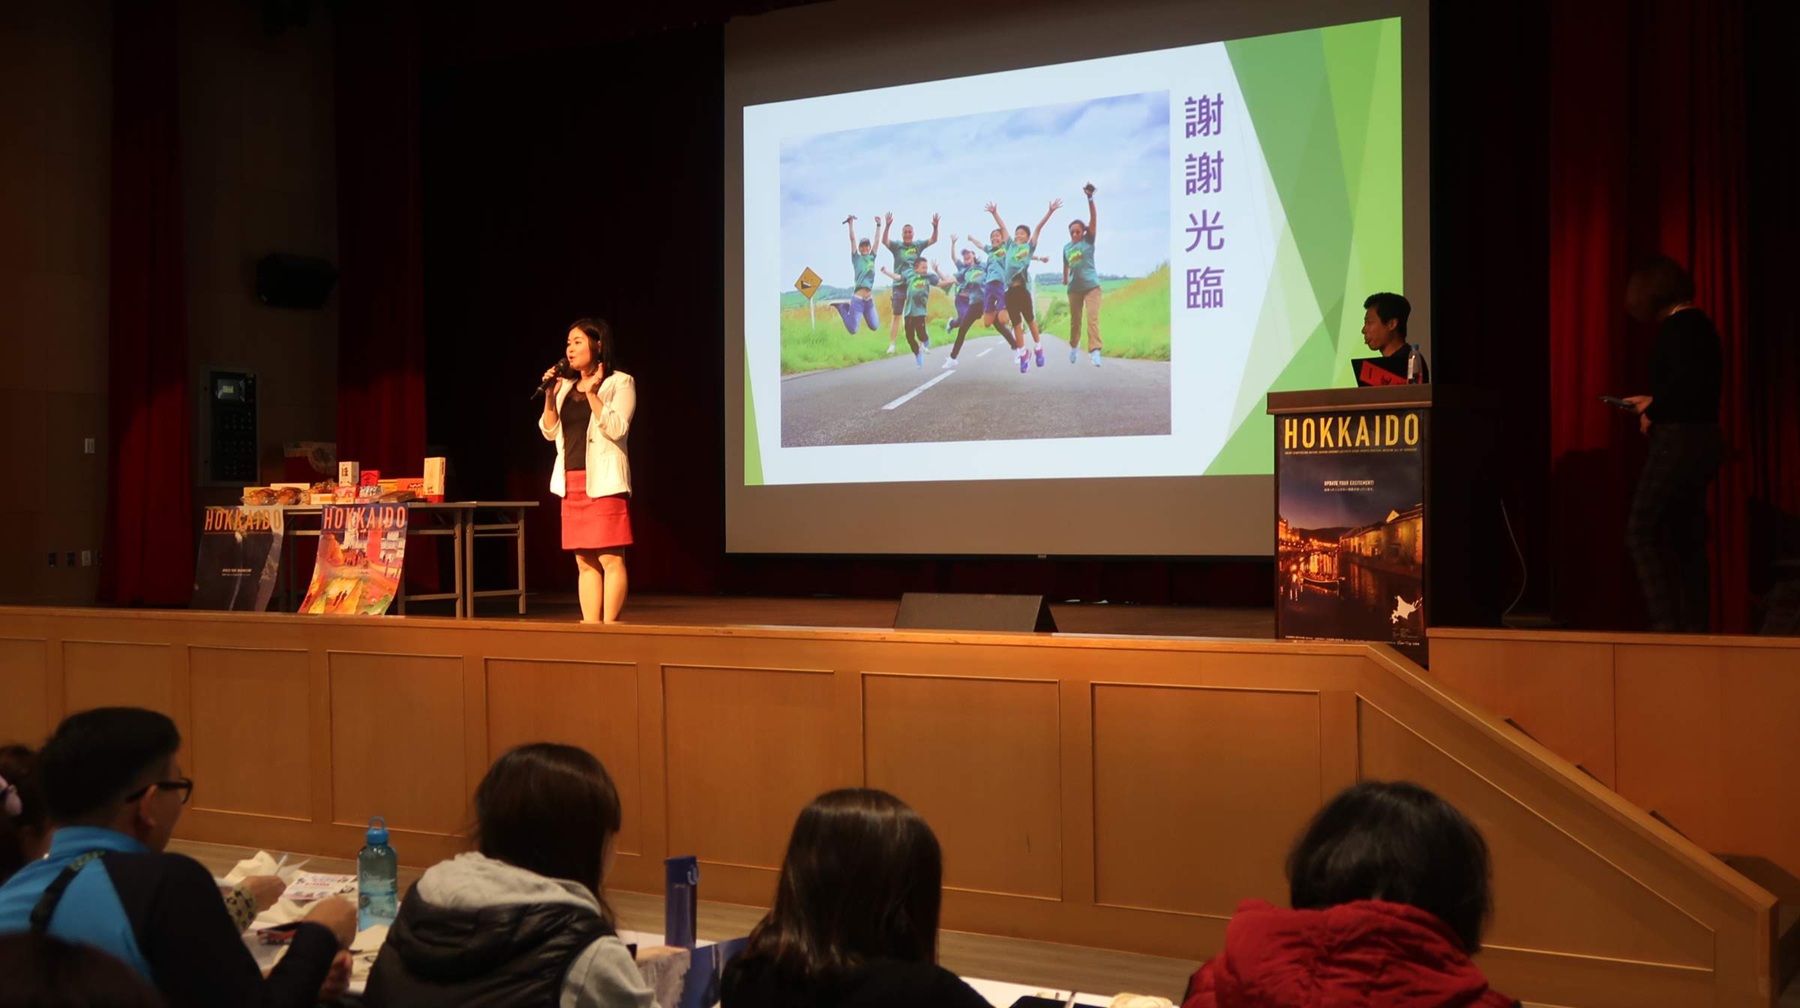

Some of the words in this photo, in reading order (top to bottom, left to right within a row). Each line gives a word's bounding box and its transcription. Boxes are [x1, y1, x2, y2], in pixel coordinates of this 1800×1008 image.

[1184, 92, 1225, 309] 謝謝光臨
[1284, 413, 1419, 449] HOKKAIDO
[204, 508, 282, 531] HOKKAIDO
[323, 506, 406, 529] HOKKAIDO
